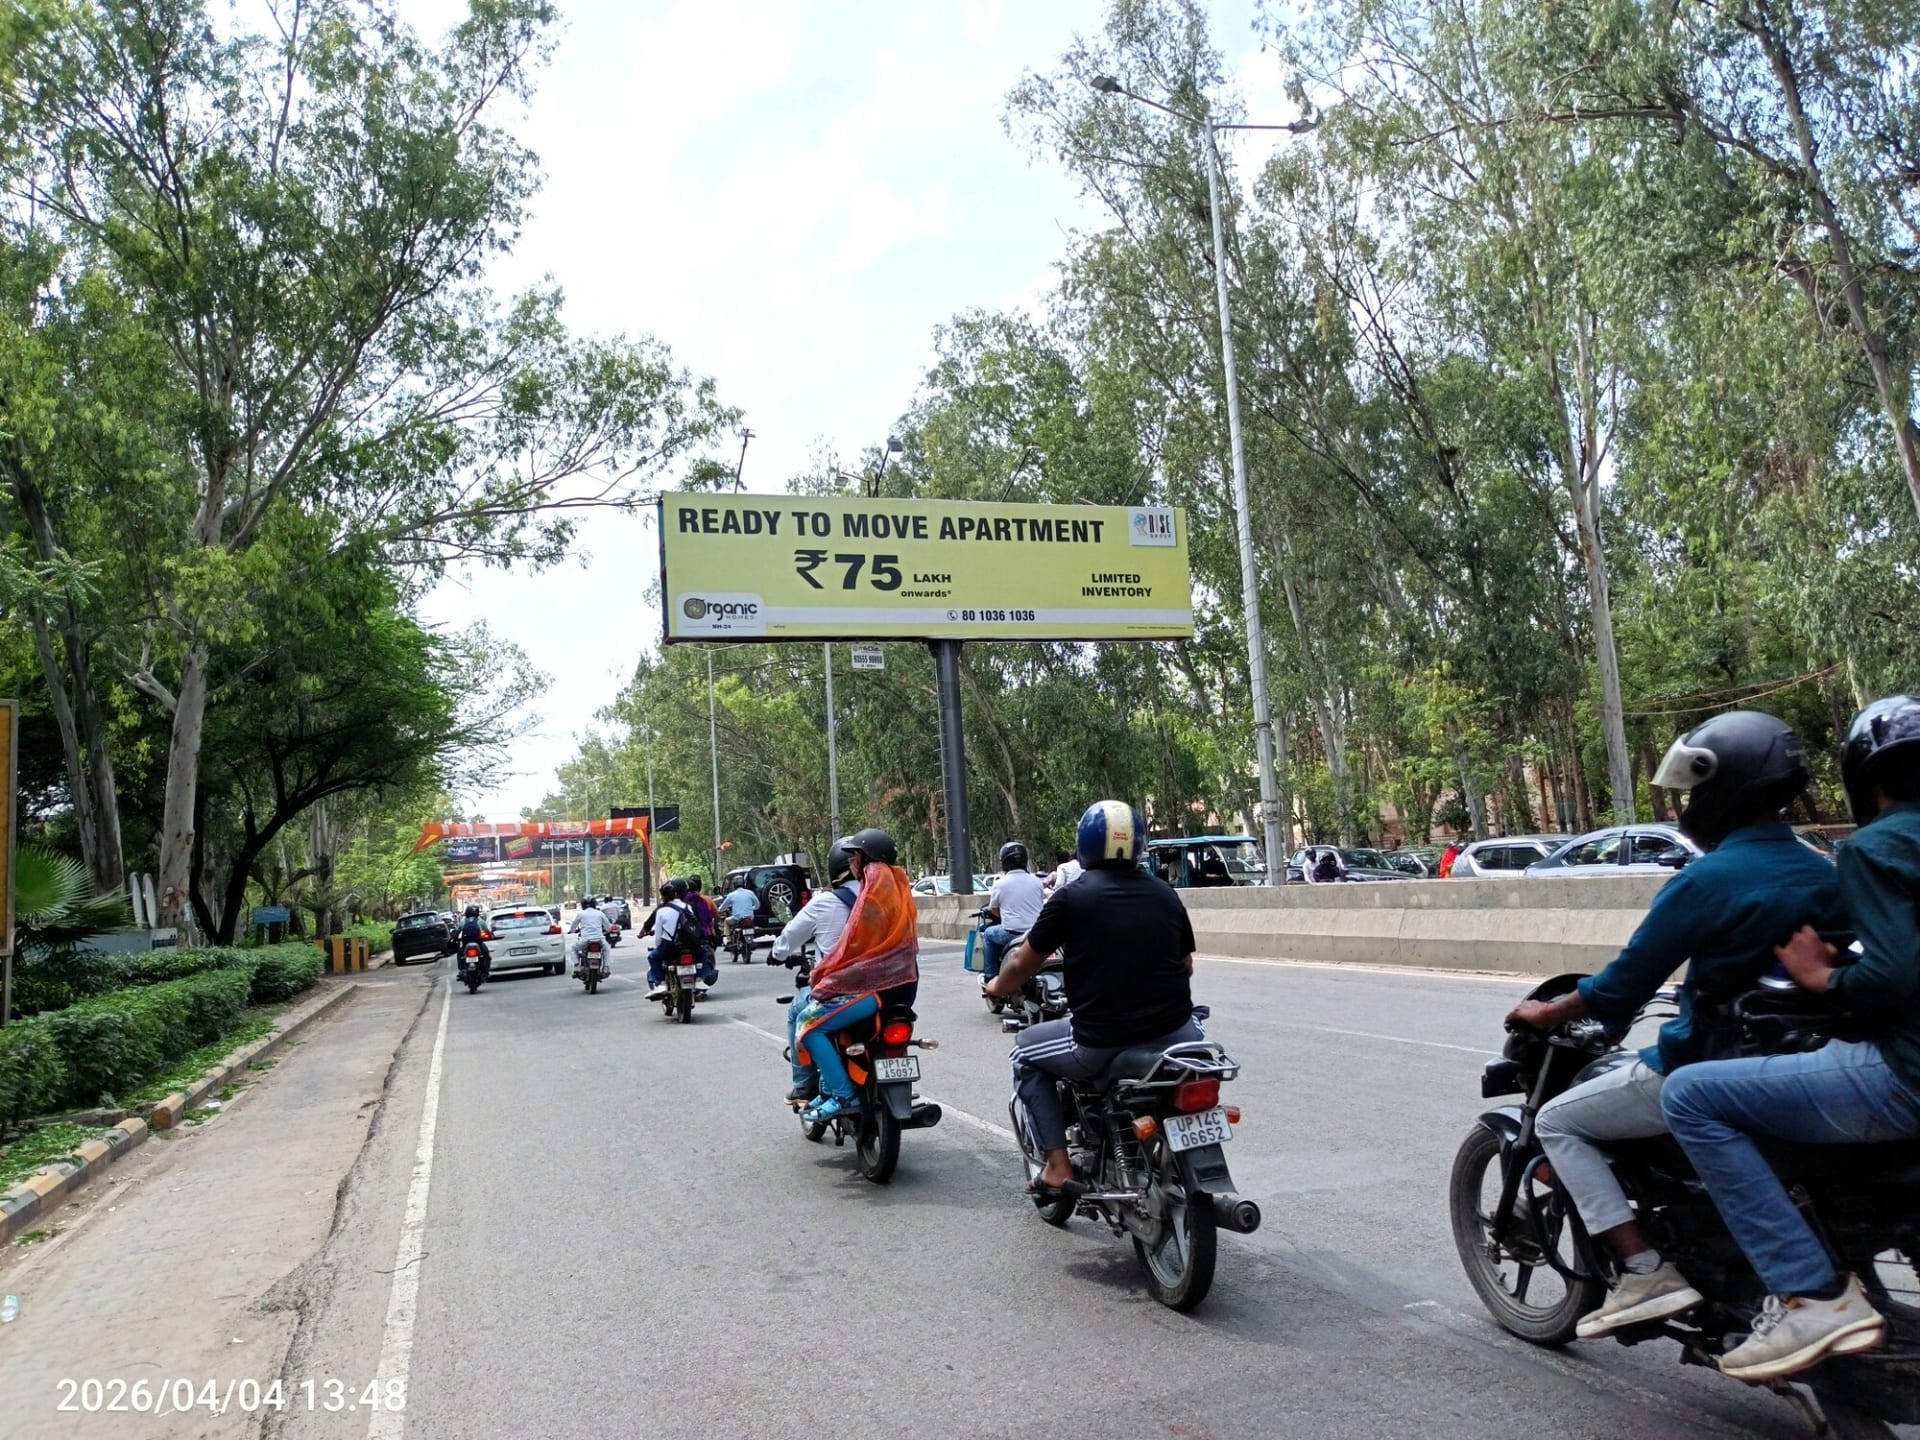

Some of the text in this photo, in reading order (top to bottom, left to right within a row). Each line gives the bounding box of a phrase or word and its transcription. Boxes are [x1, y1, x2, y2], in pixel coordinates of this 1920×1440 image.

[678, 508, 1104, 543] READY TO MOVE APARTMENT
[1149, 514, 1171, 533] RISE
[913, 573, 952, 583] LAKH
[1091, 573, 1141, 584] LIMITED
[1081, 586, 1152, 597] INVENTORY
[961, 610, 1035, 621] 80 1036 1036
[1176, 1111, 1221, 1133] UP14C
[1180, 1126, 1225, 1147] 06652
